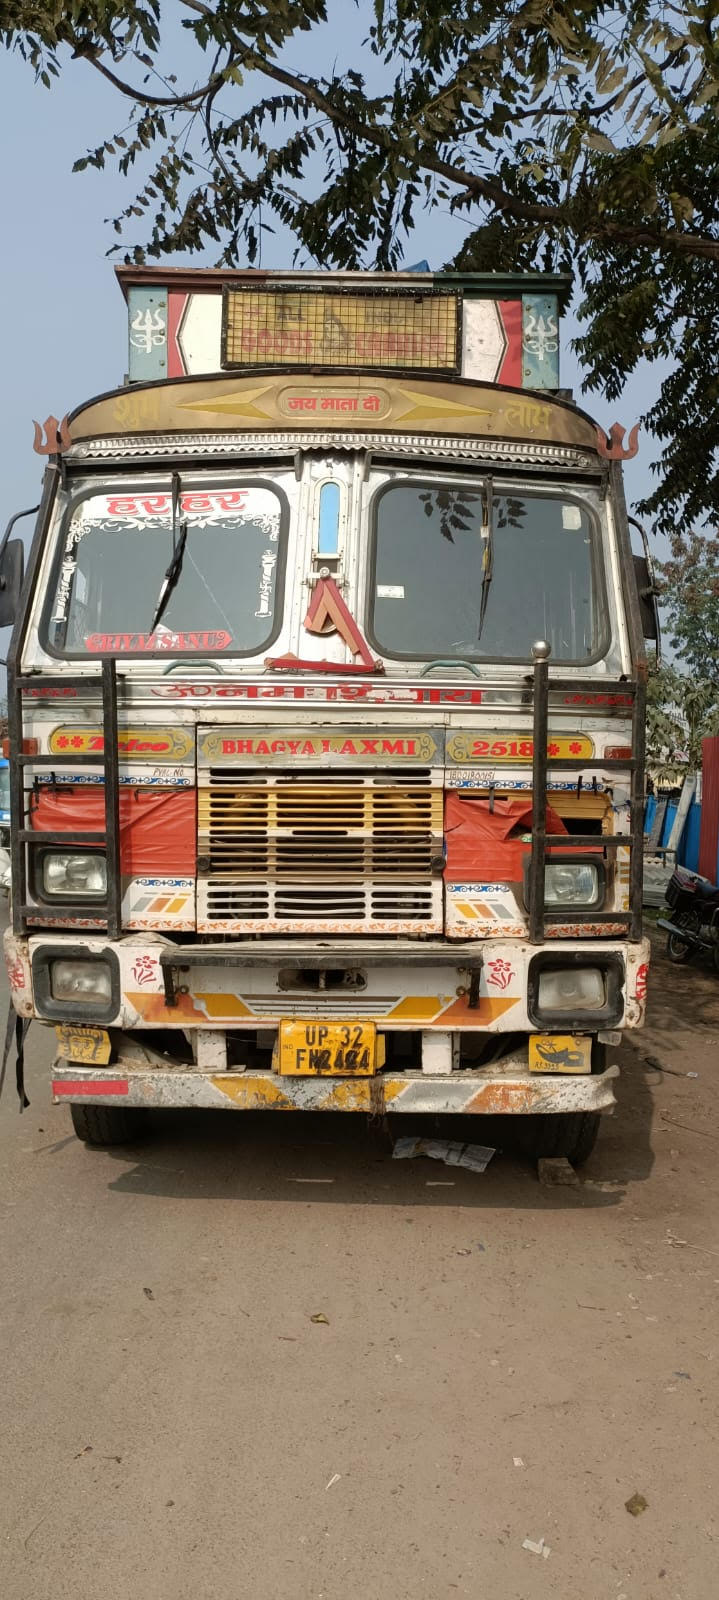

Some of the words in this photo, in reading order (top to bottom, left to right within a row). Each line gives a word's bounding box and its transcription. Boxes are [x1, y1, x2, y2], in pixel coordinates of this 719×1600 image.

[241, 328, 313, 354] GOODS
[287, 397, 318, 411] जय
[320, 397, 359, 411] माता
[362, 395, 381, 411] दी
[106, 495, 172, 515] हर
[180, 491, 248, 512] हर
[222, 740, 316, 755] BHAGYA
[320, 740, 417, 755] LAXMI
[471, 740, 534, 756] 2518
[305, 1026, 328, 1047] UP
[341, 1026, 363, 1049] 32
